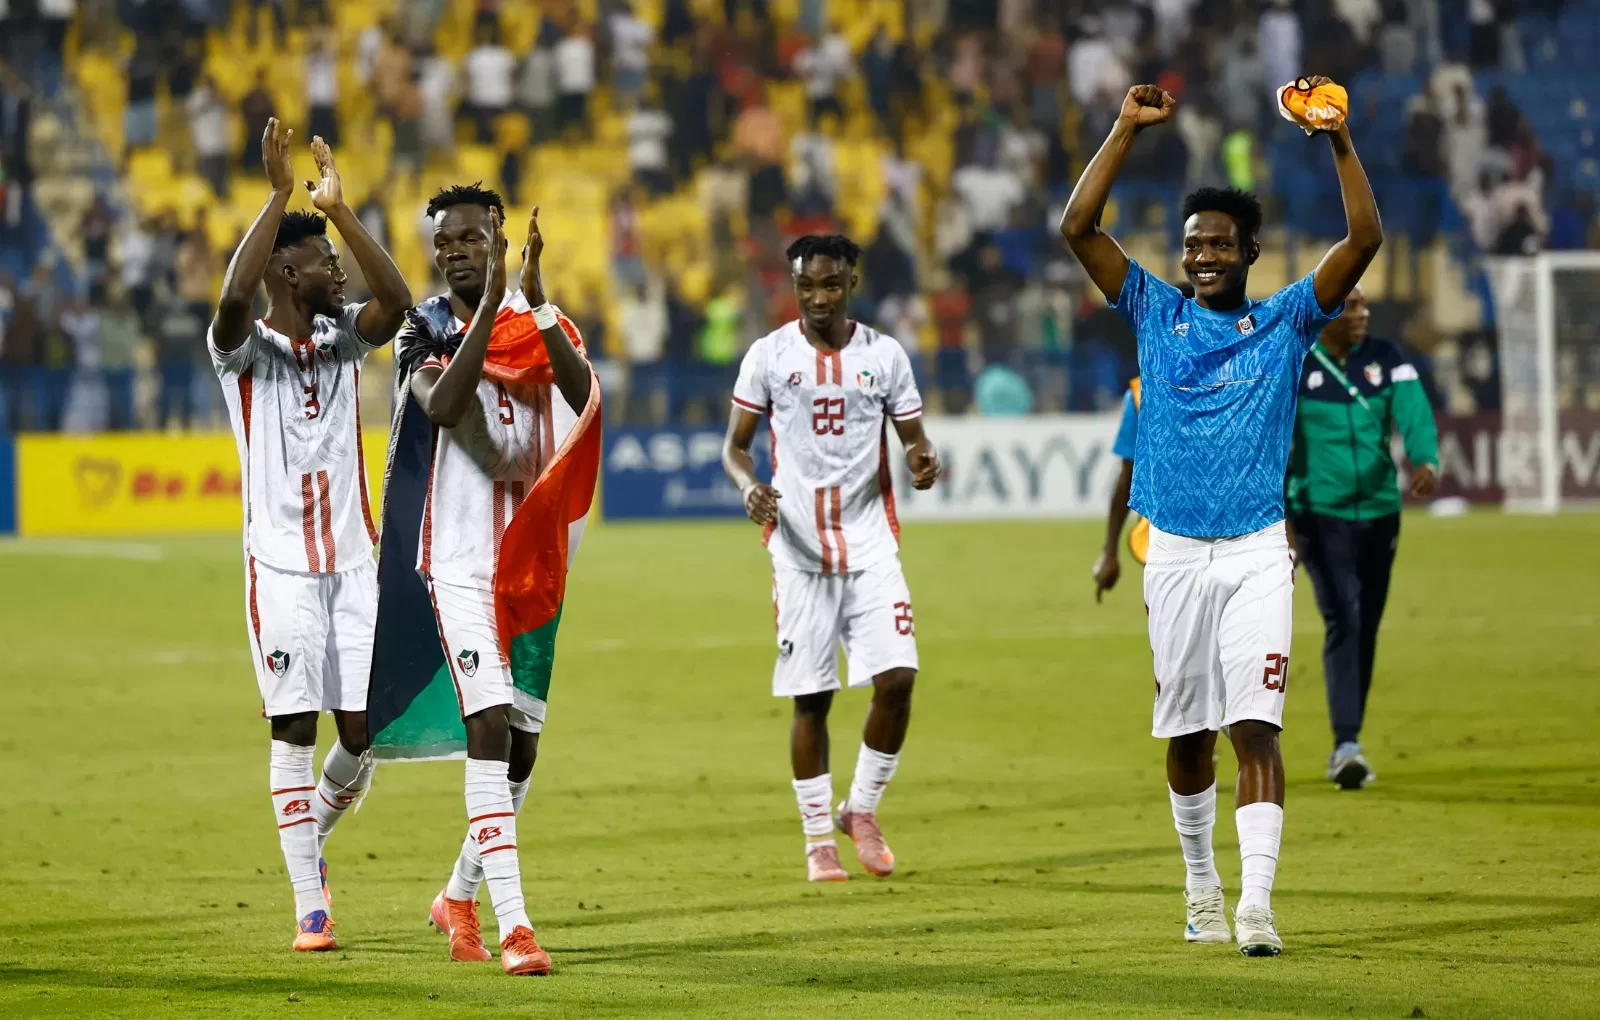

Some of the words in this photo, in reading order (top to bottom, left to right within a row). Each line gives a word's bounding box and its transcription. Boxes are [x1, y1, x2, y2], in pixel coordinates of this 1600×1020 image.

[304, 382, 320, 420] 3
[497, 381, 514, 425] 5
[812, 397, 845, 436] 22
